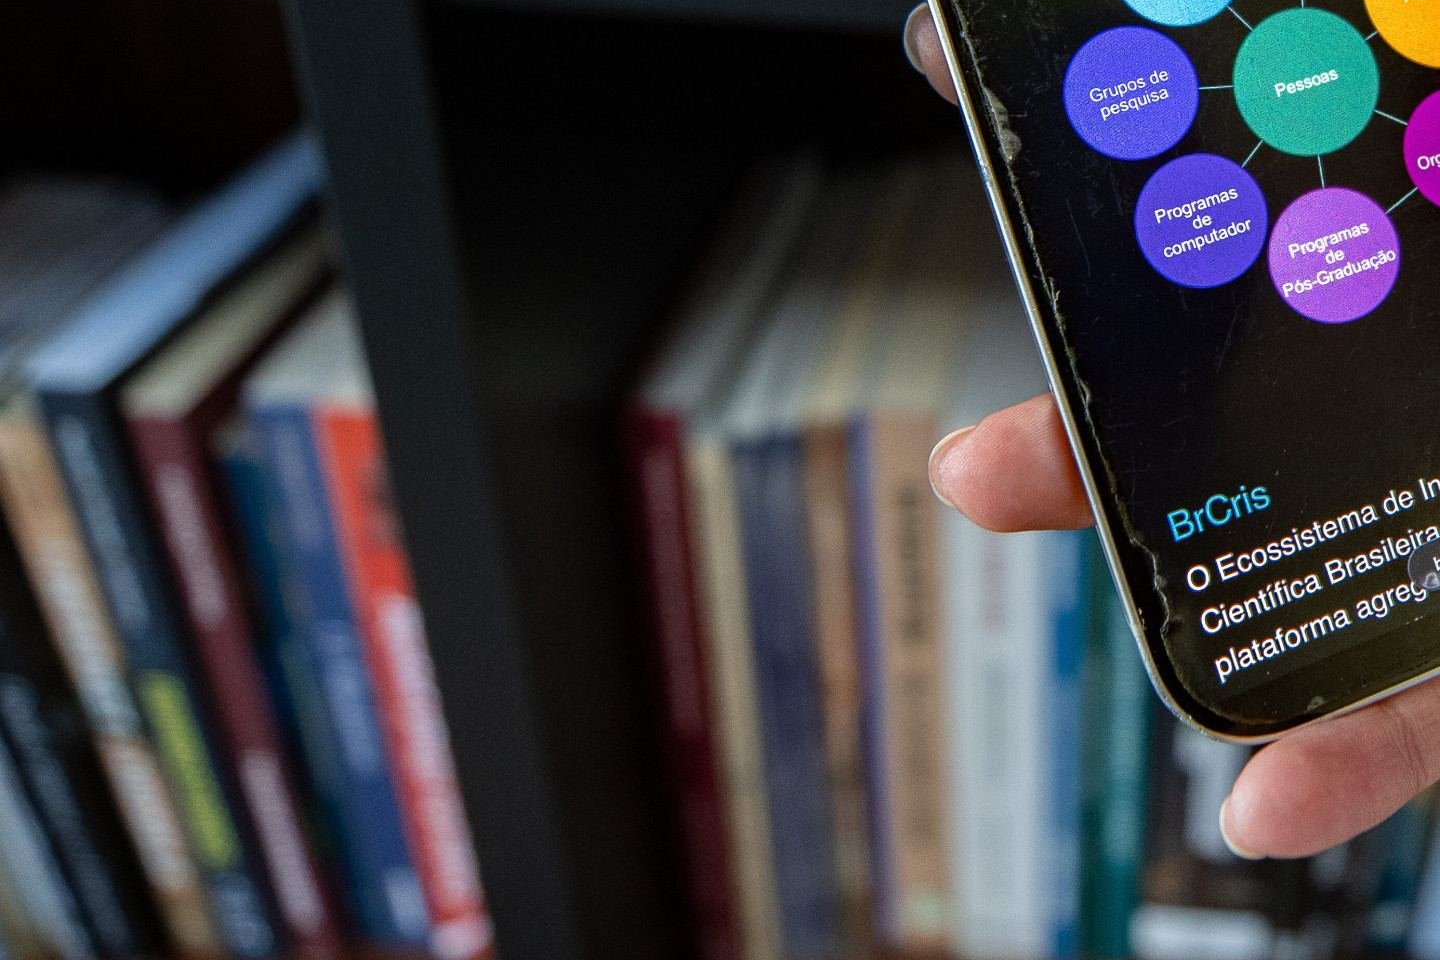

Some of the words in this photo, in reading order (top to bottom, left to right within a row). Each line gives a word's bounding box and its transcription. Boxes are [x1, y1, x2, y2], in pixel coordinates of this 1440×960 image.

[1089, 77, 1146, 104] Grupos
[1149, 68, 1169, 84] de
[1274, 68, 1339, 98] Pessoas
[1100, 88, 1169, 121] pesquisa
[1154, 186, 1238, 224] Programas
[1192, 213, 1212, 228] de
[1162, 217, 1252, 259] computador
[1288, 221, 1370, 259] Programas
[1325, 247, 1345, 264] de
[1281, 248, 1397, 298] Pós-Graduação
[1167, 483, 1271, 543] BrCris
[1186, 566, 1210, 593] O
[1215, 505, 1380, 584] Ecossistema
[1382, 490, 1415, 515] de
[1201, 572, 1322, 635] Científica
[1326, 523, 1440, 585] Brasileira
[1215, 608, 1351, 685] plataforma
